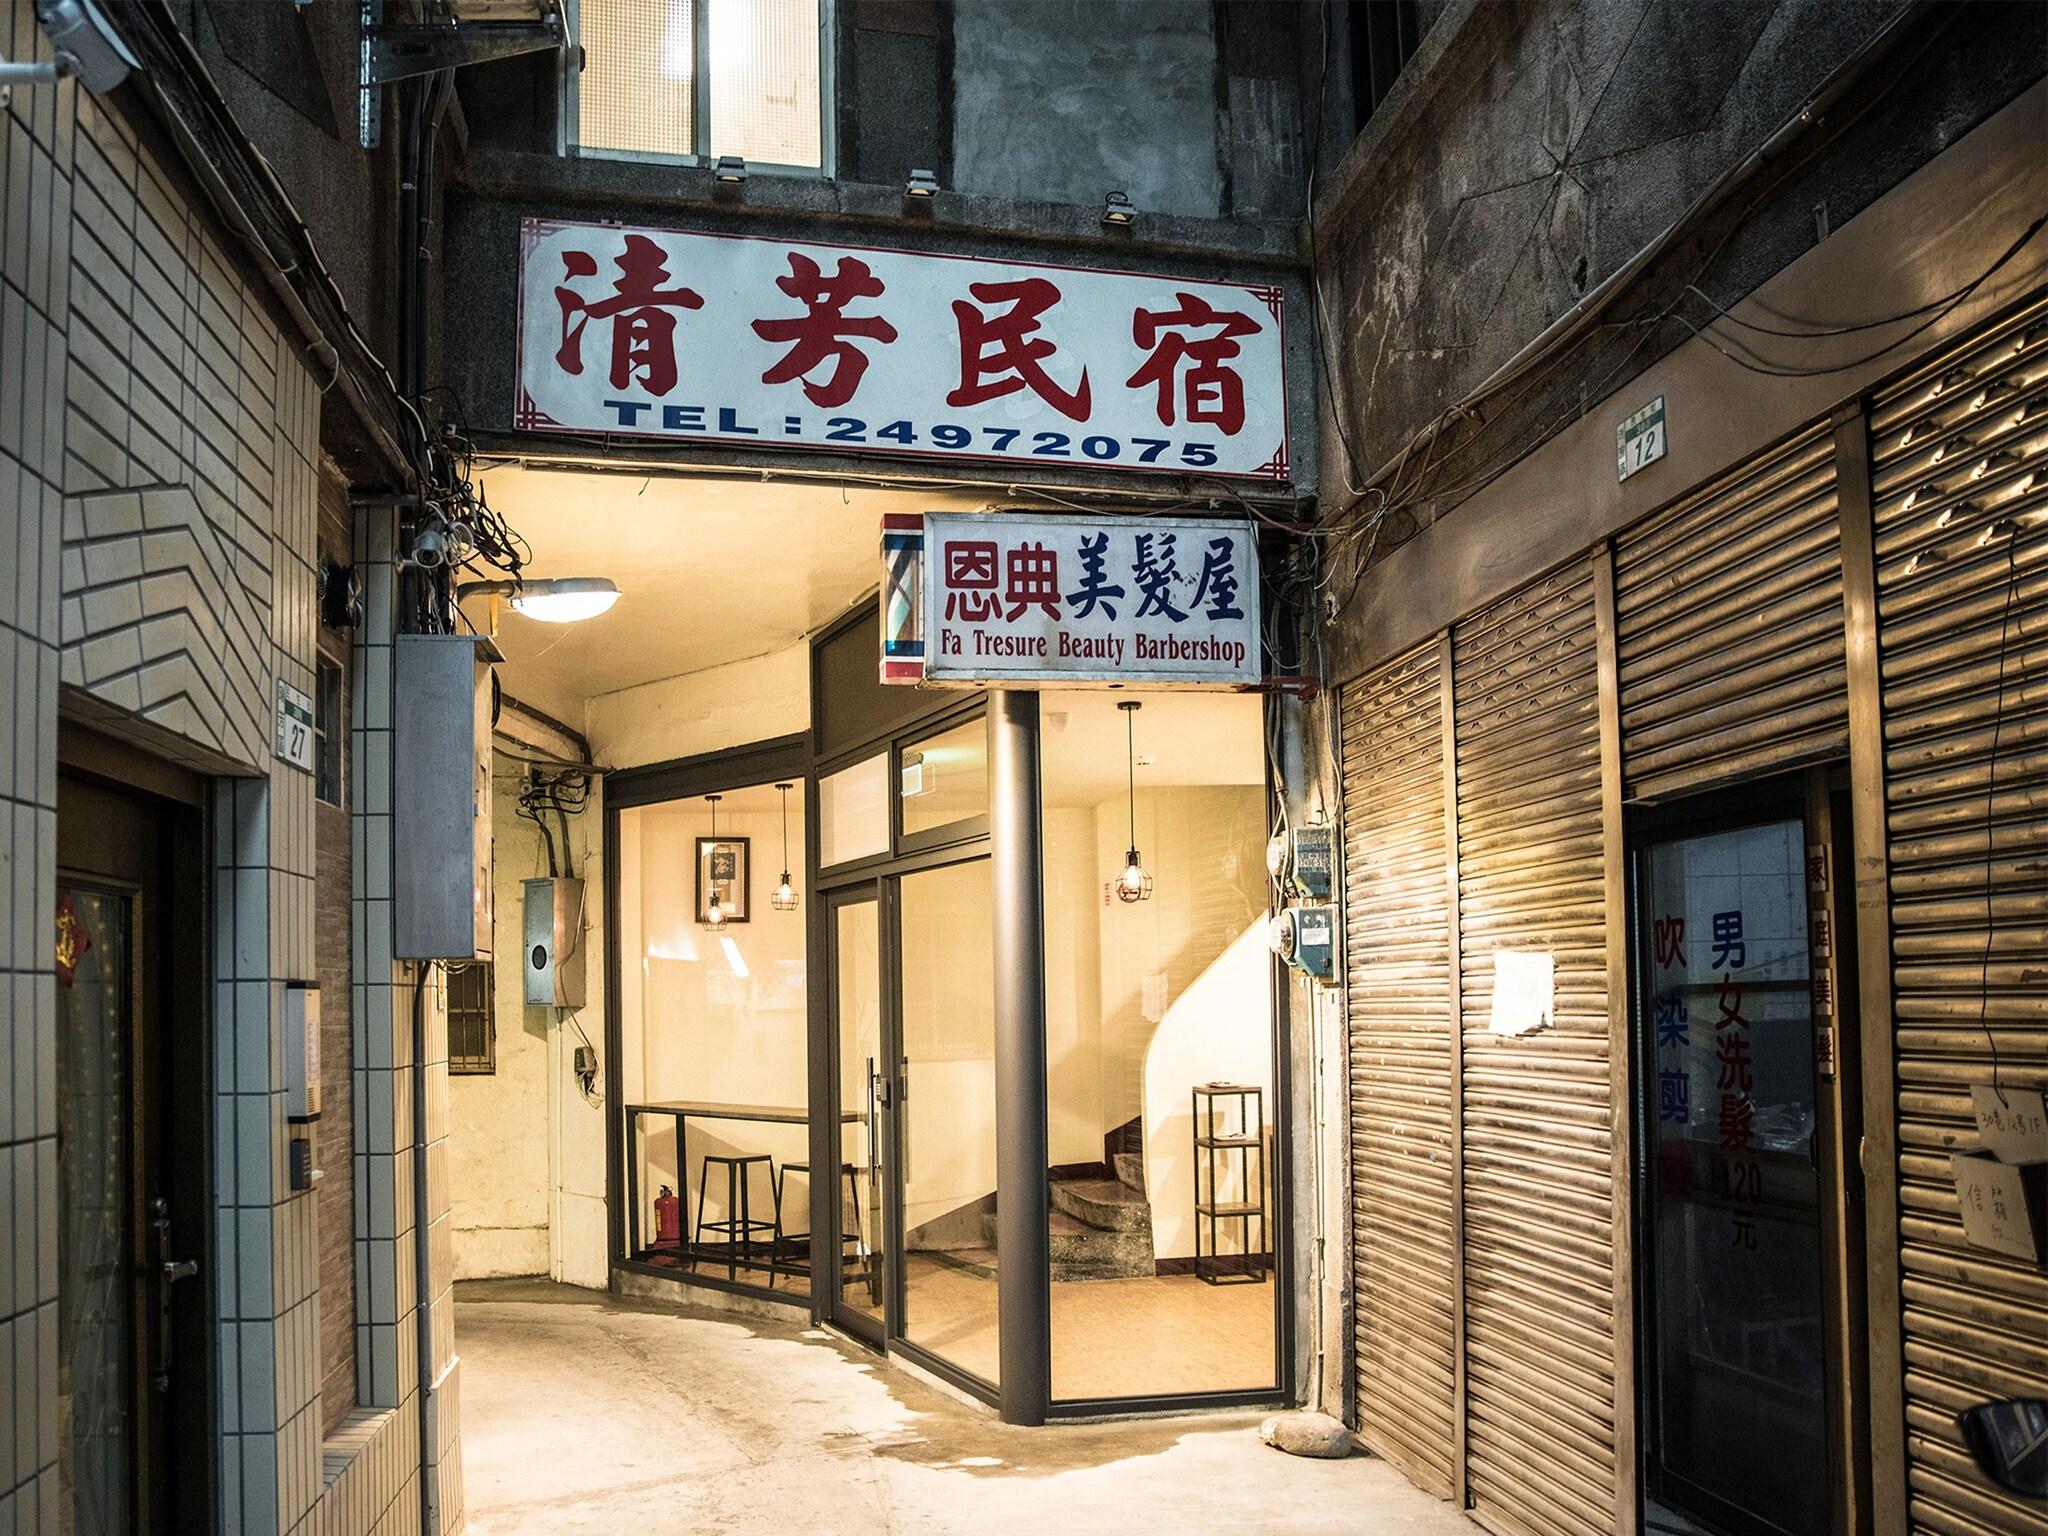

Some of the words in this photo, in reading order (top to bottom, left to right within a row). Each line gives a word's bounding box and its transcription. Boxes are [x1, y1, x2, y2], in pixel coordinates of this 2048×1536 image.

[555, 234, 1262, 436] 清芳民宿
[1636, 430, 1655, 466] 12
[944, 531, 1245, 623] 恩典美髮屋
[941, 628, 962, 655] Fa
[973, 629, 1048, 658] Tresure
[1059, 631, 1125, 667] Beauty
[1135, 632, 1246, 669] Barbershop
[291, 724, 305, 760] 27
[1654, 913, 1692, 1197] 吹染剪
